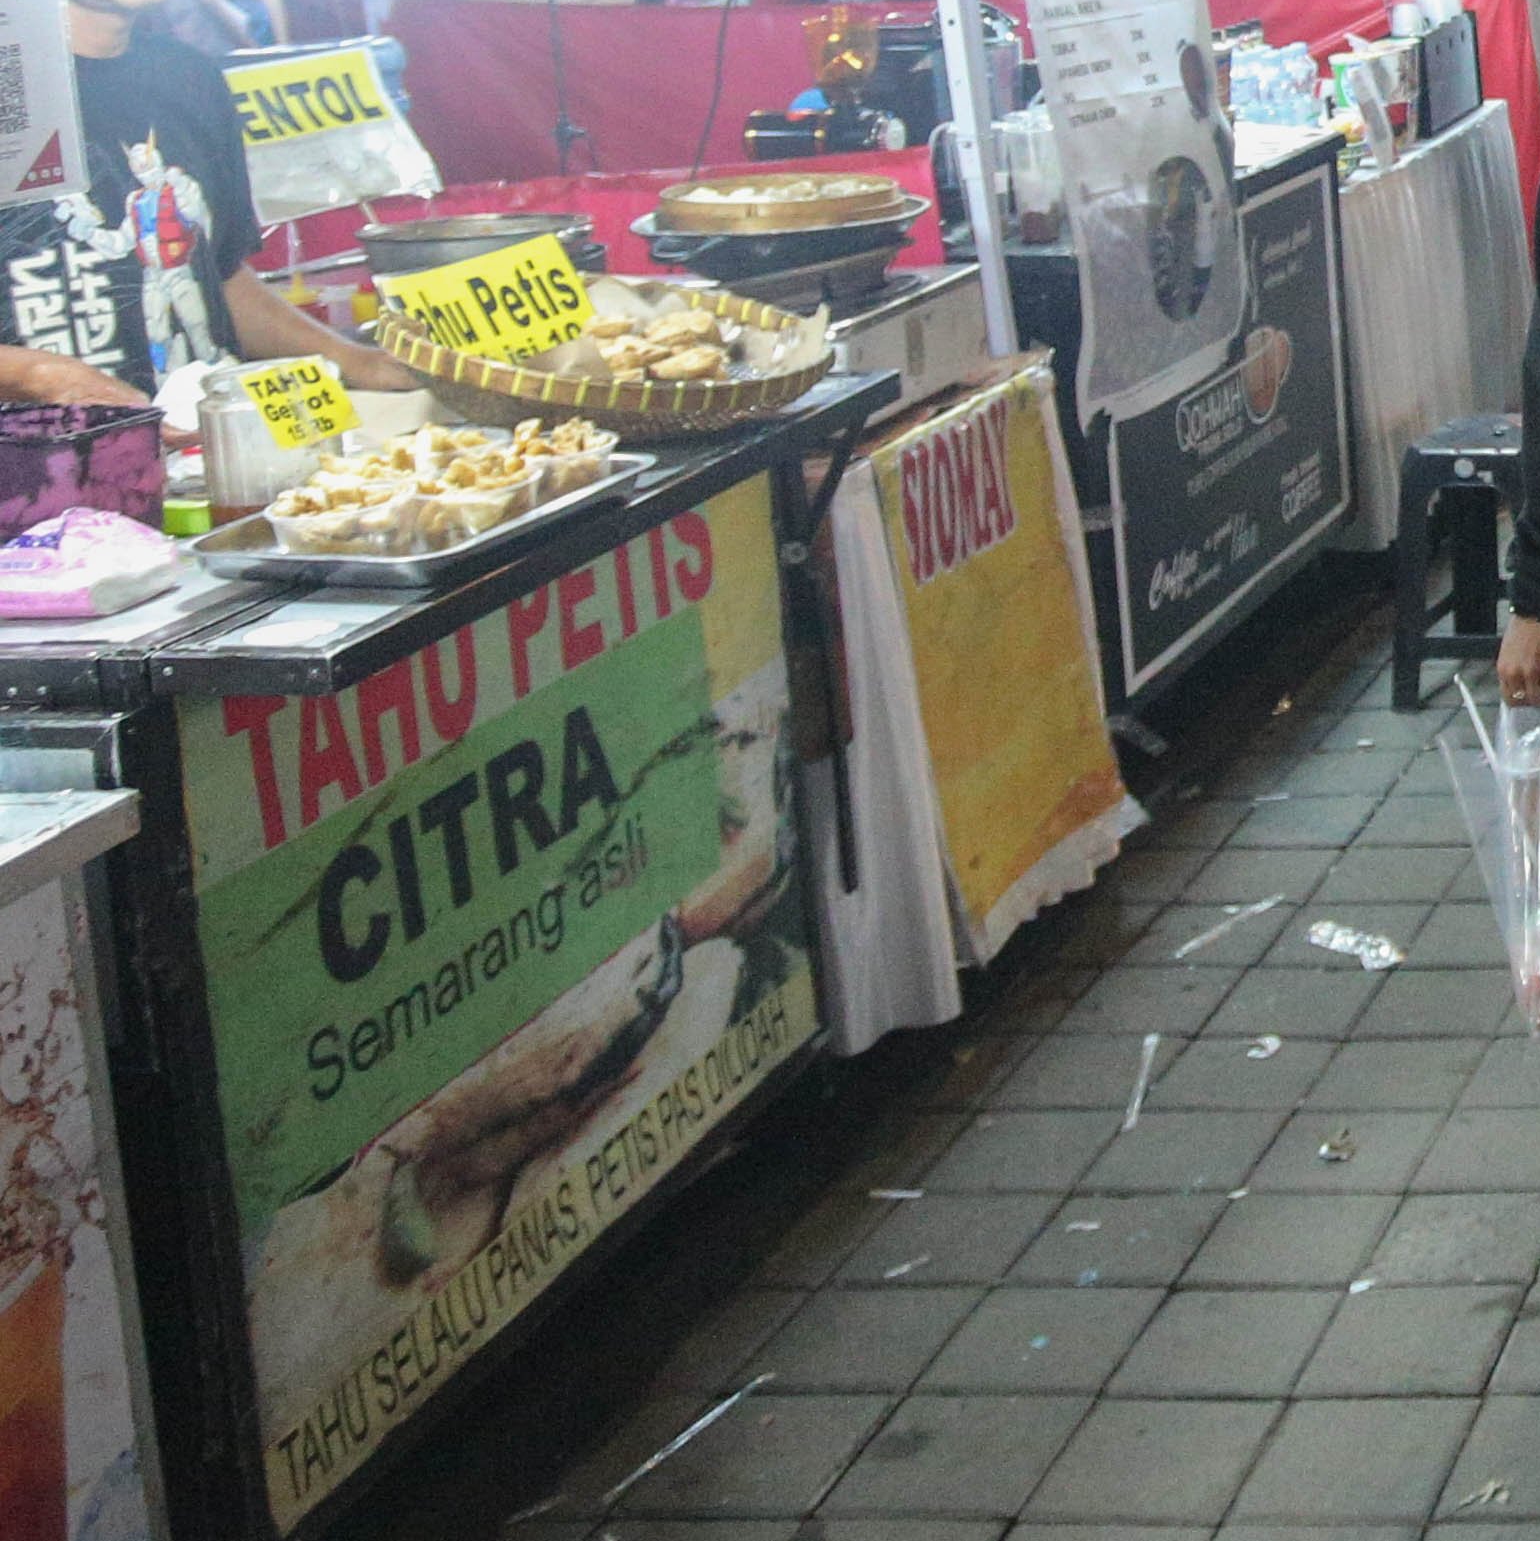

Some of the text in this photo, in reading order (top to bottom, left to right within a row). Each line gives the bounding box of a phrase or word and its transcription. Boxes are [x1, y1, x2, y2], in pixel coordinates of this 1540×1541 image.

[232, 73, 383, 140] ENTOL
[246, 365, 321, 400] TAHU
[389, 260, 580, 349] ahu Petis
[224, 506, 714, 850] TAHU PETIS
[308, 813, 649, 1101] Semarang asli
[314, 706, 621, 984] CITRA
[277, 1389, 370, 1501] TAHU
[370, 1279, 490, 1430] SELALU
[587, 1127, 657, 1216] PETIS
[659, 1081, 703, 1154] PAS
